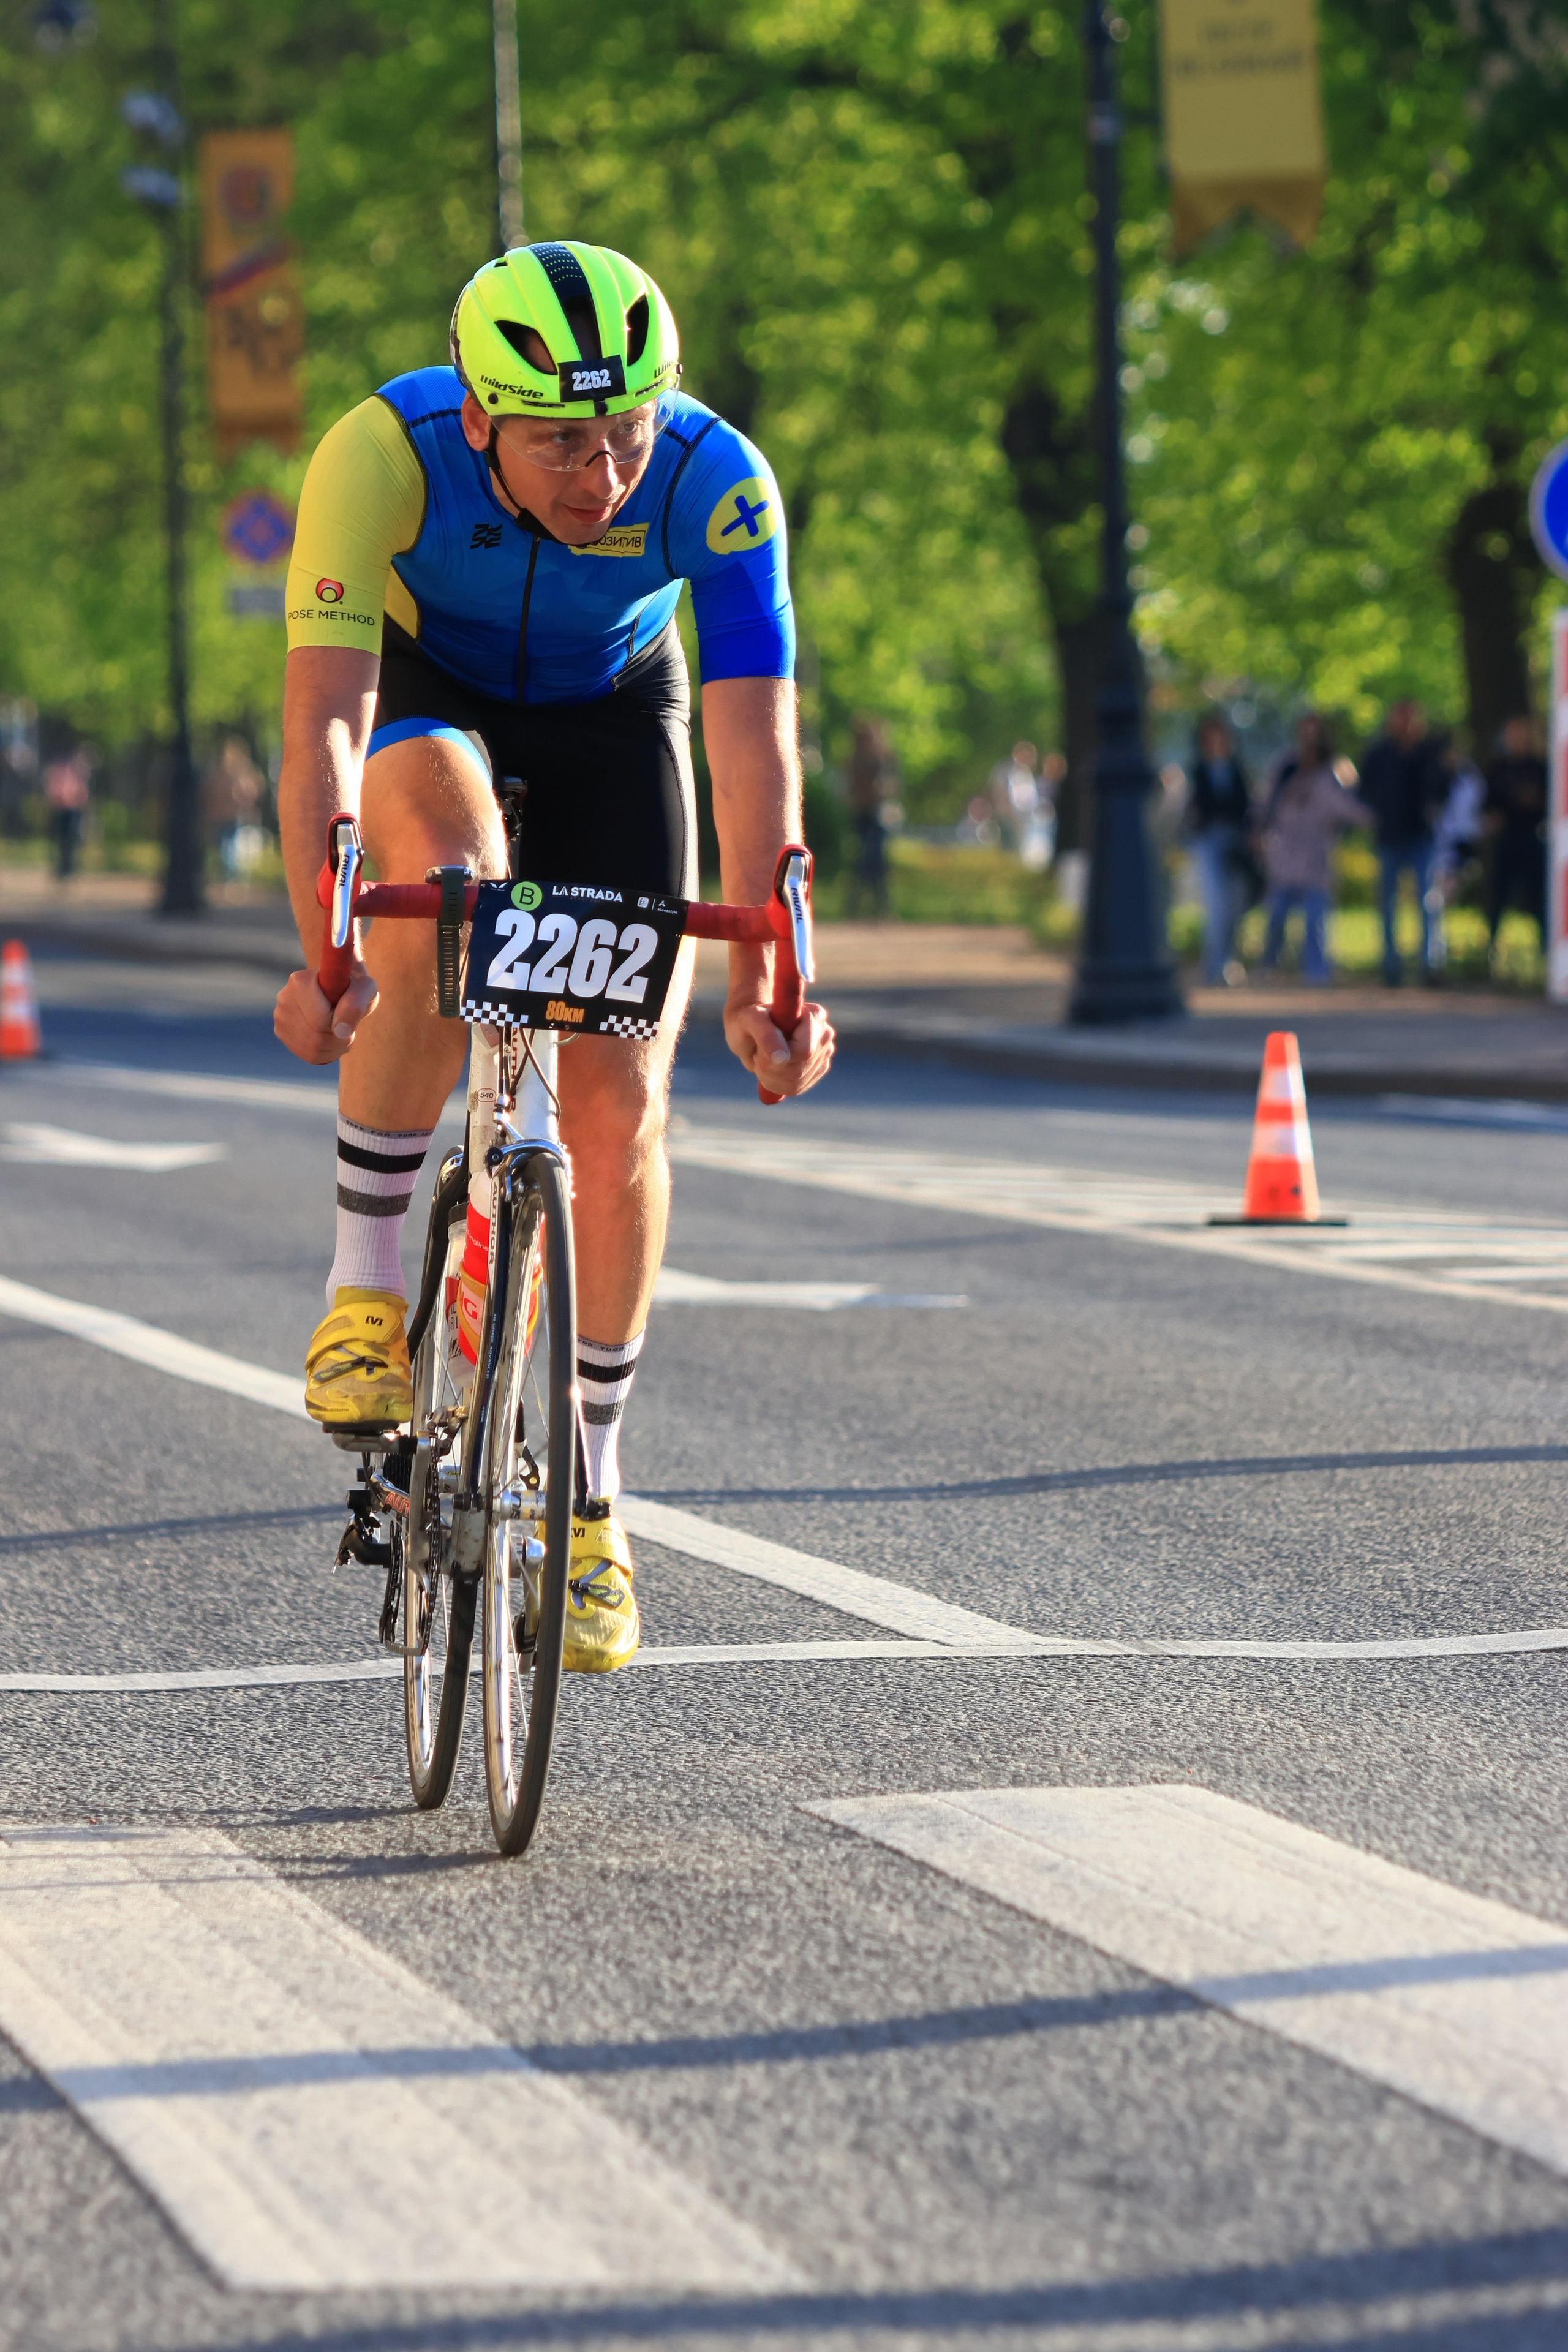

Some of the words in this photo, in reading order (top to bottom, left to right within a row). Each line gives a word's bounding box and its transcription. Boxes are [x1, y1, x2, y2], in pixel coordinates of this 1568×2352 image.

[571, 369, 611, 391] 2262
[600, 536, 641, 548] ОЗИТИВ
[288, 609, 314, 621] POSE
[318, 610, 375, 625] METHOD
[338, 854, 350, 889] RIVAL
[519, 886, 535, 905] B
[552, 886, 568, 896] LA
[570, 886, 624, 903] STRADA
[791, 887, 803, 924] RIVAL
[486, 908, 658, 1003] 2262
